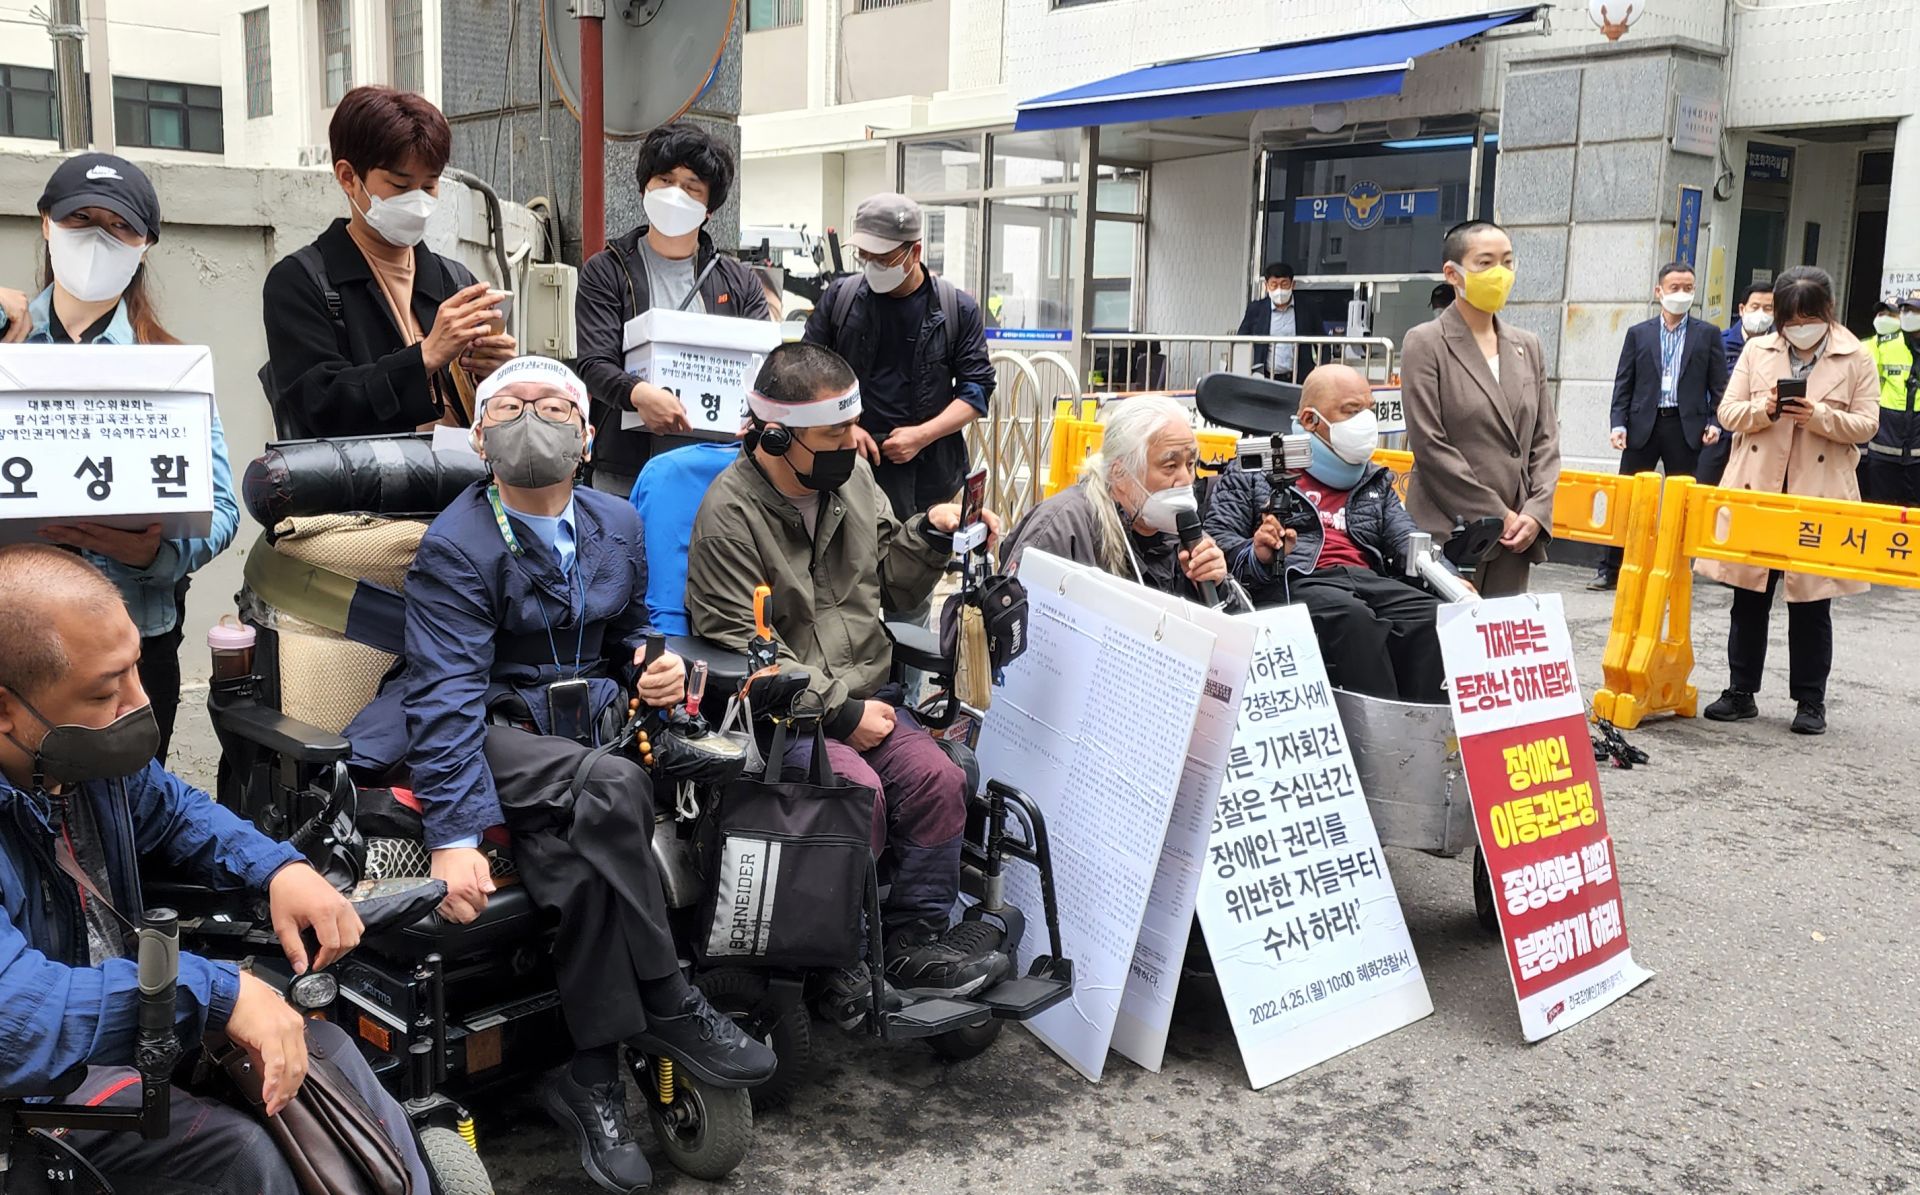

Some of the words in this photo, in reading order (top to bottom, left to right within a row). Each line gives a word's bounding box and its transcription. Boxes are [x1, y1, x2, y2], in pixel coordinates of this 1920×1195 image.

[1313, 199, 1329, 219] 안
[1400, 194, 1415, 214] 내
[700, 393, 721, 421] 형
[0, 456, 39, 499] 오
[73, 455, 113, 501] 성
[150, 454, 190, 499] 환
[1797, 521, 1824, 549] 질
[1840, 527, 1868, 555] 서
[1886, 531, 1914, 561] 유
[1475, 618, 1550, 659] 기재부는
[1242, 680, 1329, 722] 경찰조사에
[1455, 668, 1512, 714] 돈장난
[1255, 723, 1343, 769] 기자회견
[1502, 735, 1573, 792] 장애인
[1270, 763, 1356, 813] 수십년간
[1209, 829, 1282, 879] 장애인
[1281, 812, 1349, 856] 권리를
[1225, 872, 1295, 924] 위반한
[1294, 847, 1382, 899] 자들부터
[1500, 851, 1584, 916] 중앙정부
[1580, 839, 1613, 886] 책임
[1263, 916, 1309, 961] 수사
[1513, 911, 1592, 981] 분명하게
[1588, 898, 1622, 949] 하라!
[1326, 970, 1356, 993] 10:00
[1356, 949, 1413, 983] 혜화경찰서
